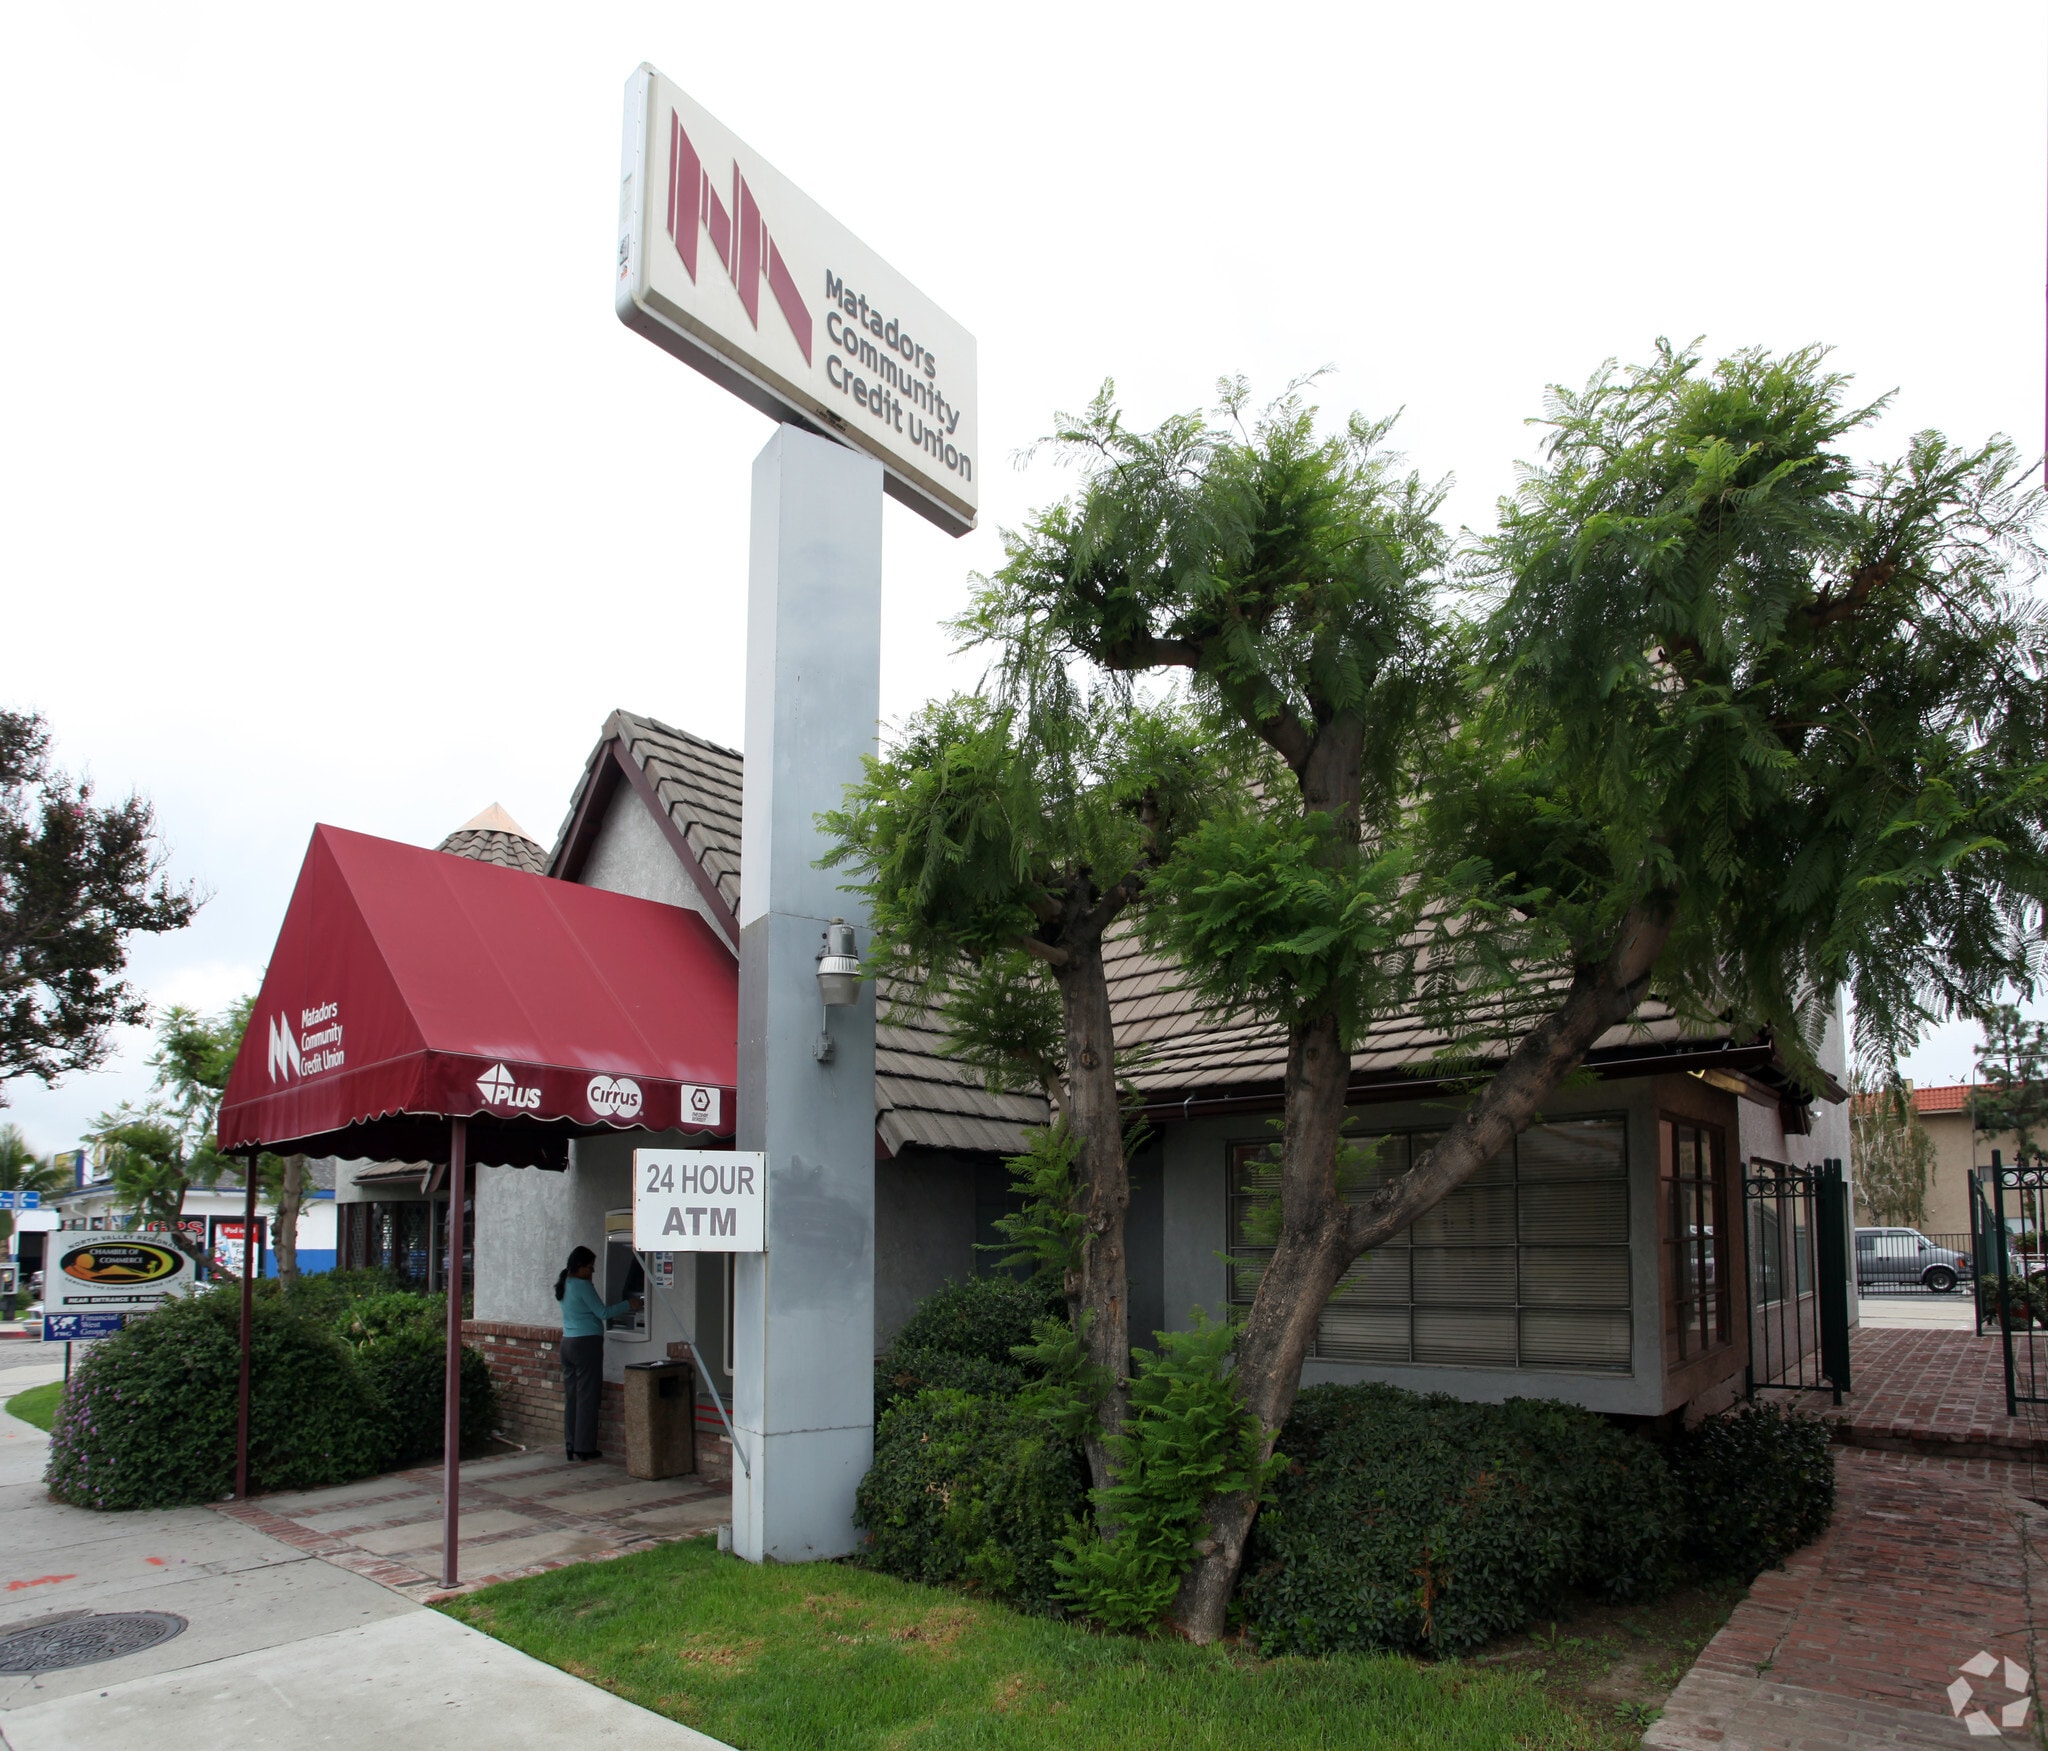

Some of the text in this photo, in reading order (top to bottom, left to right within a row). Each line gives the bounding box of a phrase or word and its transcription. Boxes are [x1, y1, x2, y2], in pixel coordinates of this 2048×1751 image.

[826, 268, 937, 379] Matadors
[826, 311, 960, 435] Community
[826, 354, 972, 482] Credit Union
[301, 1001, 338, 1029] Matadors
[301, 1022, 343, 1052] Community
[300, 1047, 345, 1077] Credit Union
[493, 1085, 542, 1109] PLUS
[590, 1086, 639, 1107] Cirrus
[646, 1164, 755, 1195] 24 HOUR
[662, 1207, 737, 1236] ATM
[68, 1236, 99, 1249] NORTH
[80, 1328, 107, 1337] Group
